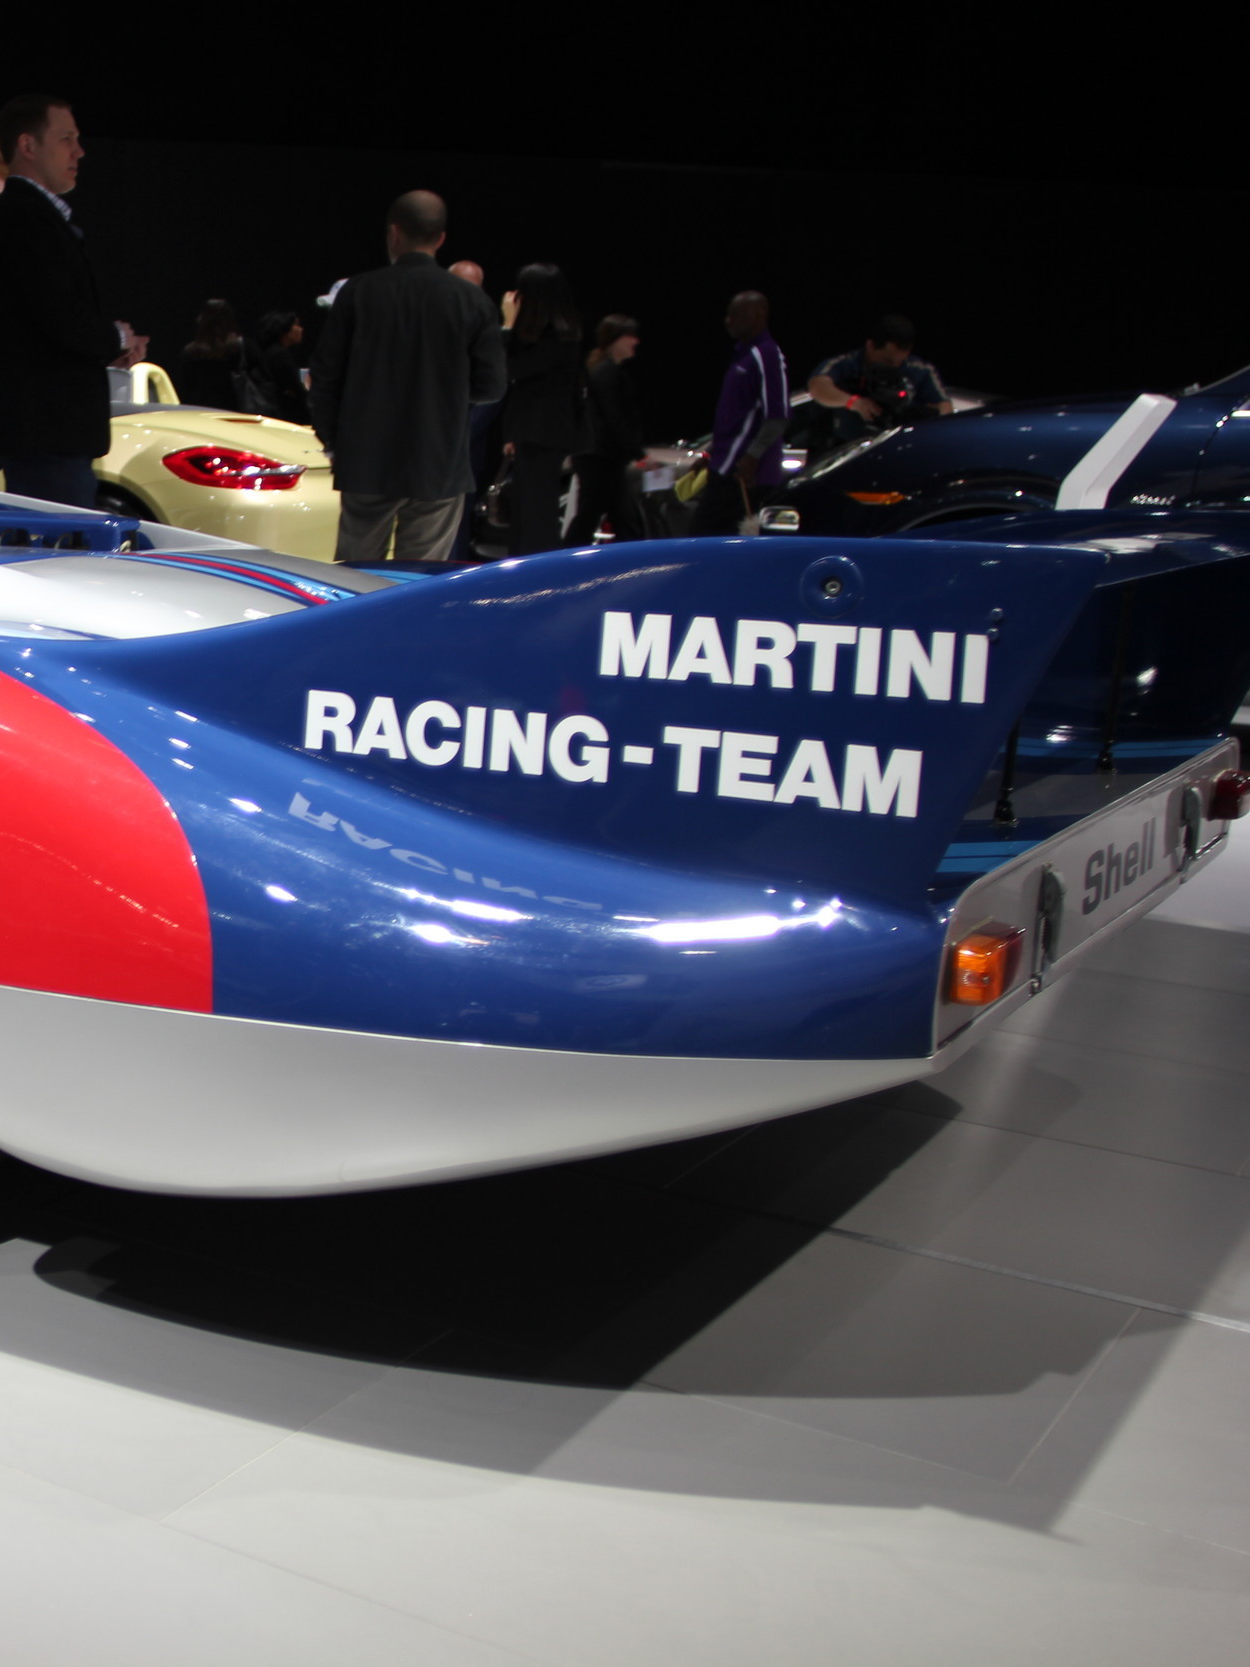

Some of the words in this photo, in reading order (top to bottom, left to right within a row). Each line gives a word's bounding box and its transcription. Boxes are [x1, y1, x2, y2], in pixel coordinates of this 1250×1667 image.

[598, 610, 990, 705] MARTINI
[302, 689, 923, 819] RACING-TEAM
[1082, 816, 1157, 915] Shell
